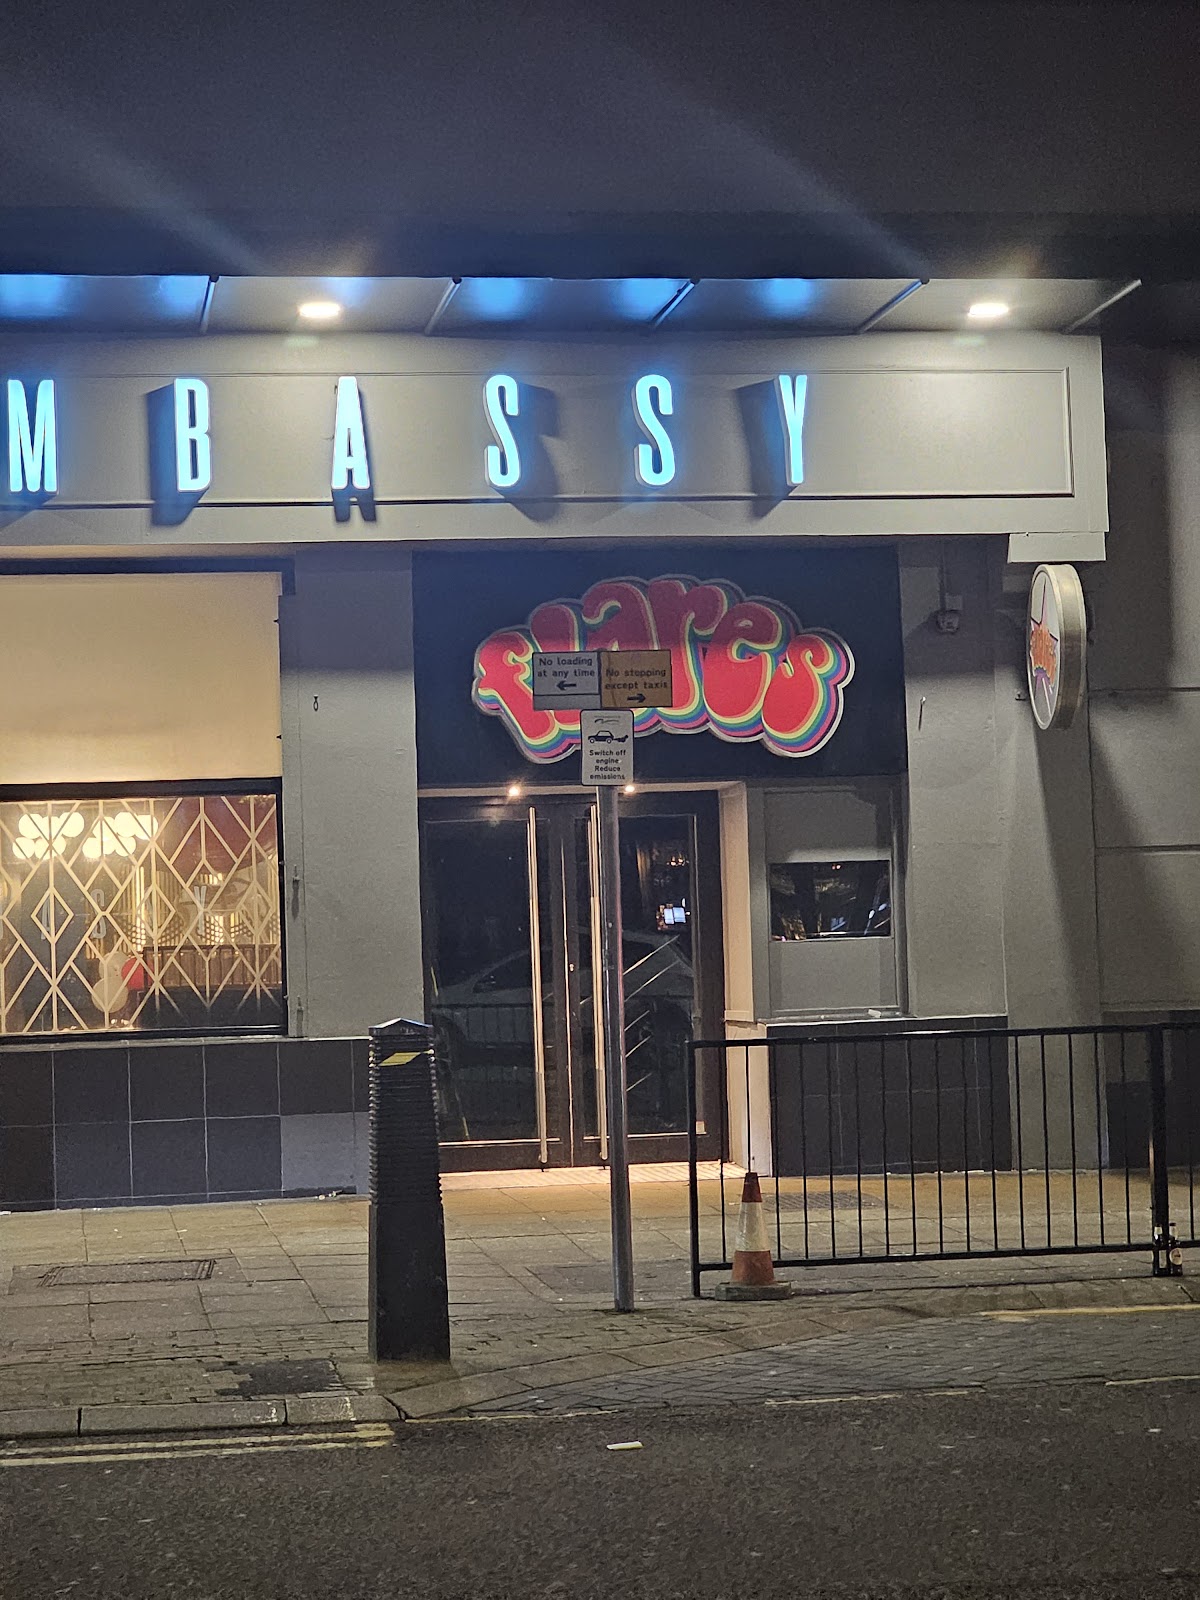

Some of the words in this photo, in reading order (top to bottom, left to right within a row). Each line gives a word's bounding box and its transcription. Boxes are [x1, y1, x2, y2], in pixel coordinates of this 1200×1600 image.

[539, 657, 553, 666] No
[557, 656, 593, 666] loading
[537, 669, 547, 677] at
[552, 669, 569, 679] any
[574, 669, 595, 677] time
[605, 669, 620, 677] No
[624, 668, 666, 678] stopping
[605, 681, 638, 690] except
[643, 681, 668, 689] taxis
[595, 757, 619, 765] engine
